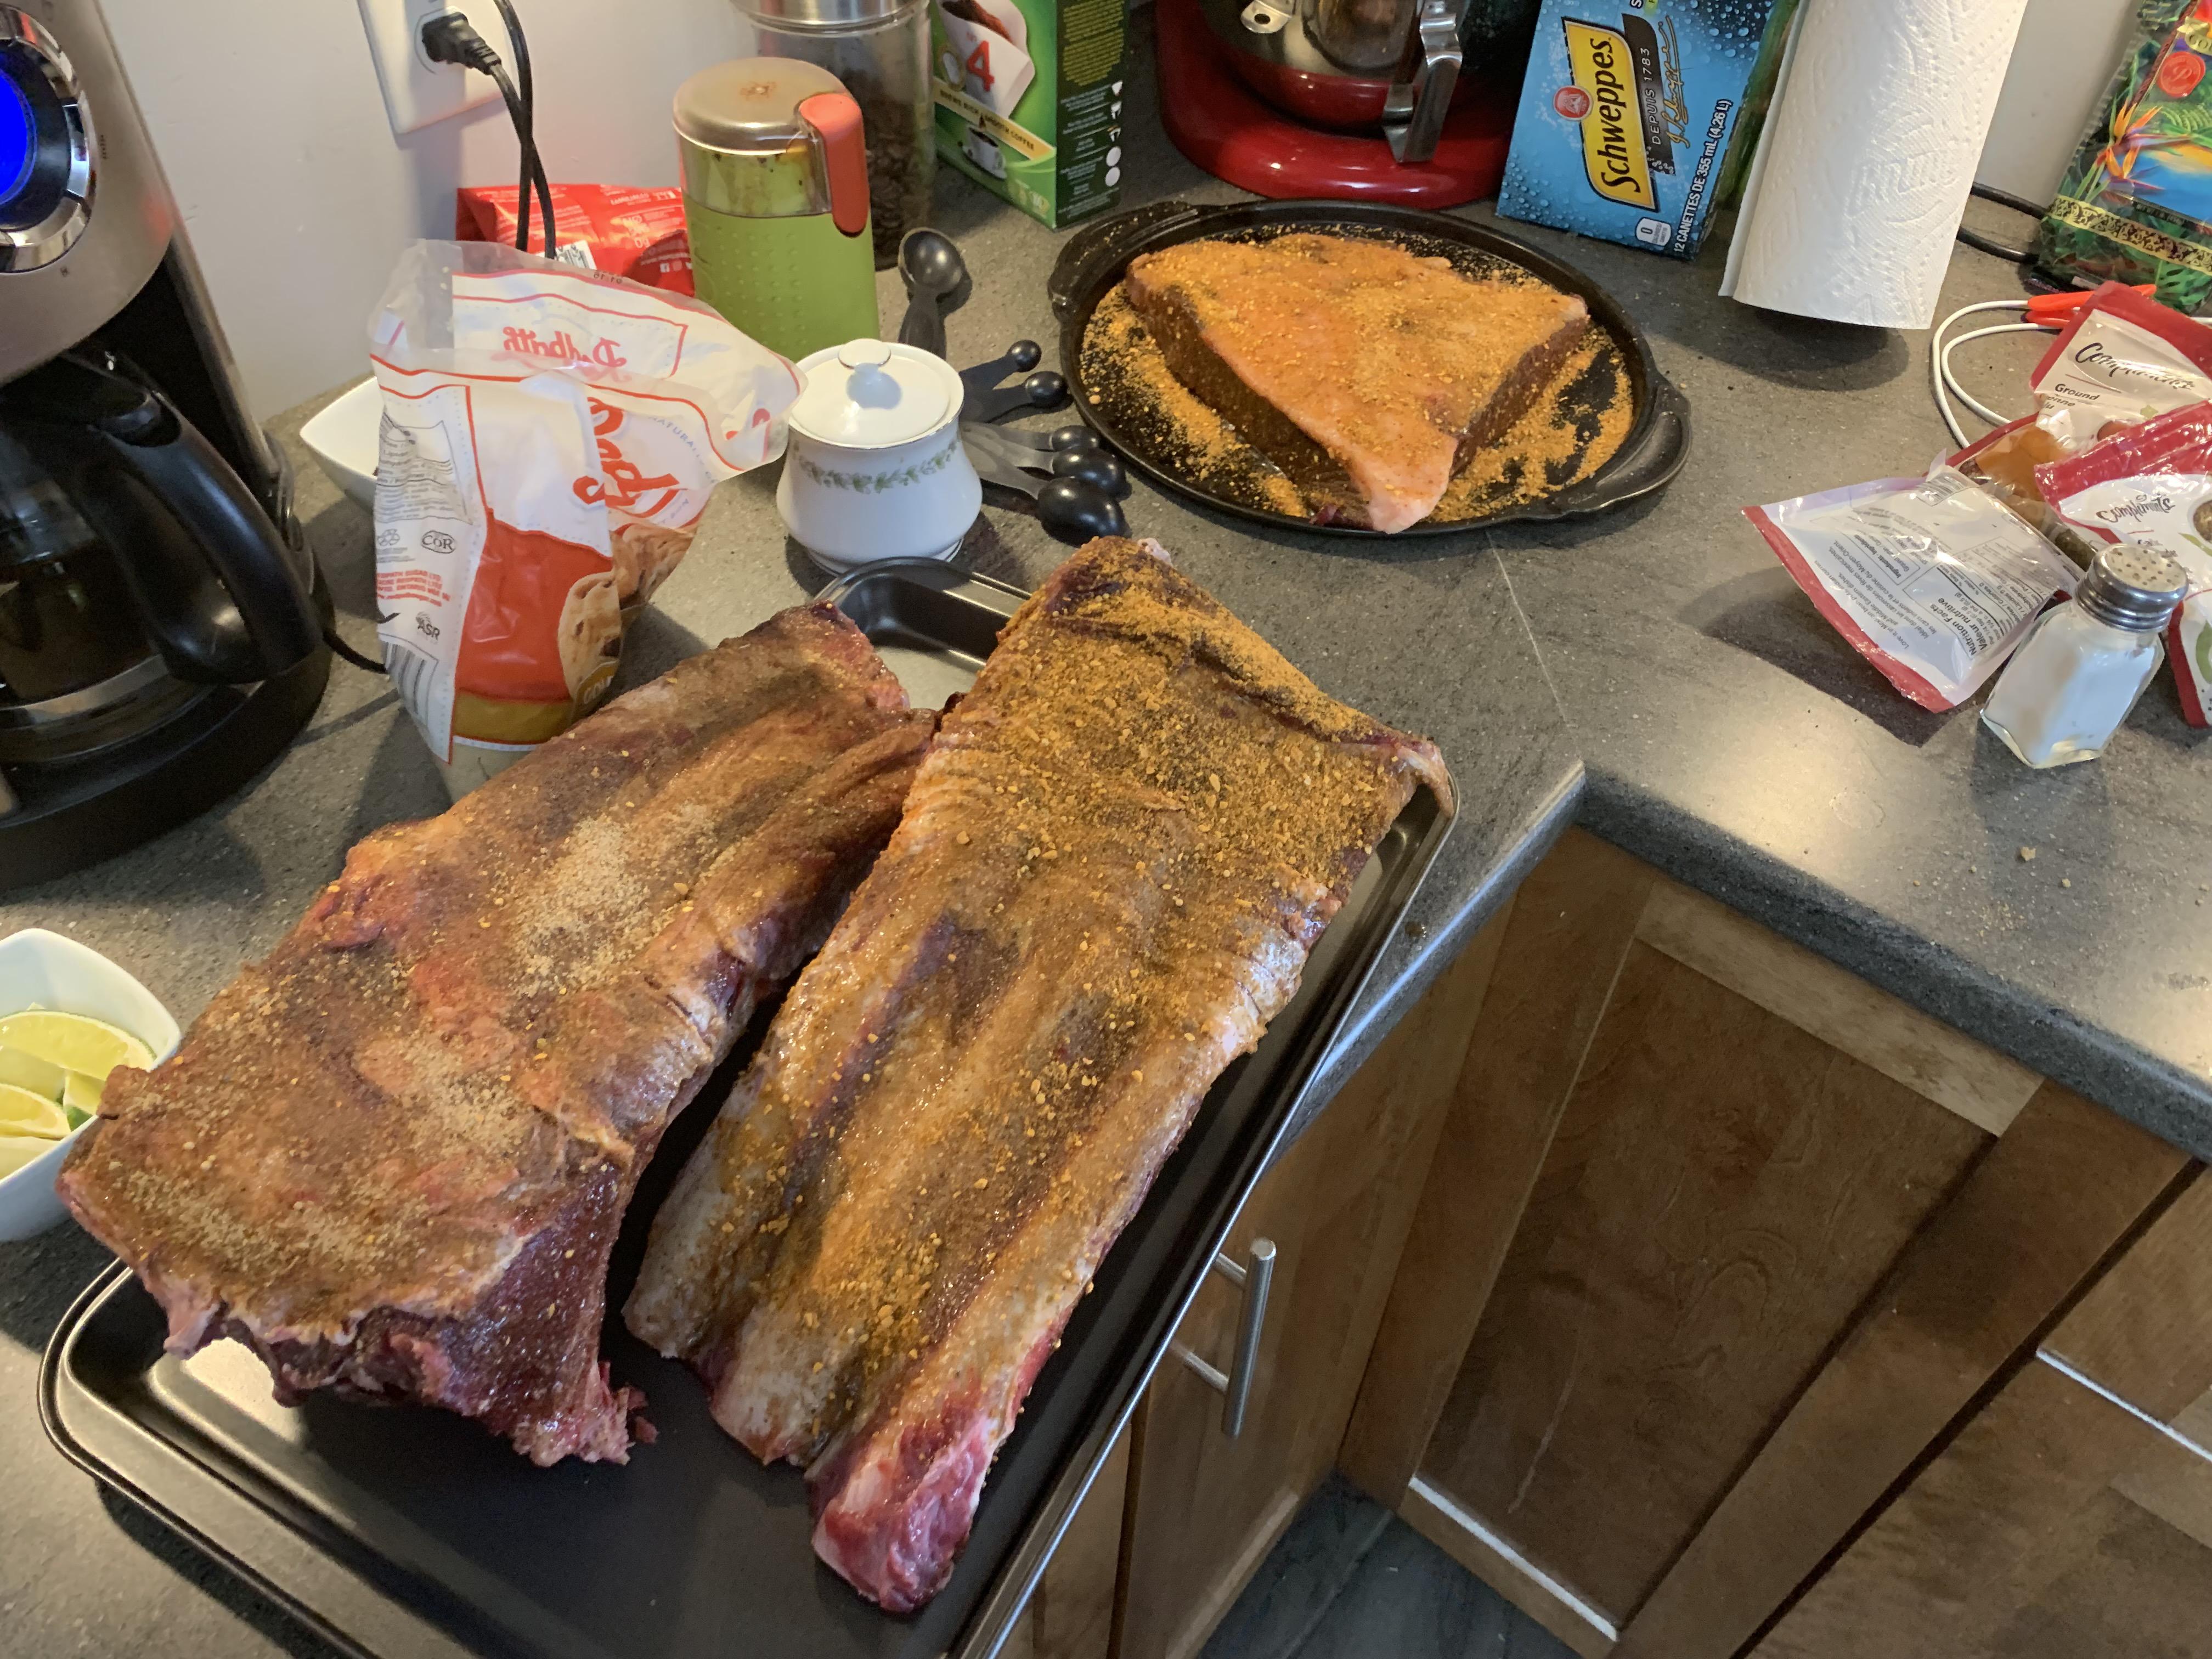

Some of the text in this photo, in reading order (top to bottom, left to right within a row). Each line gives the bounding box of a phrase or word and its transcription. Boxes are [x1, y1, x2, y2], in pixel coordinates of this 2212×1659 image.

[967, 40, 995, 92] 4
[1640, 48, 1661, 145] DEPUIS 1783
[1590, 37, 1641, 193] Schweppes
[1708, 112, 1725, 138] (4,26
[1705, 140, 1718, 156] mL
[1697, 157, 1712, 177] 355
[1692, 177, 1705, 193] DE
[1677, 193, 1701, 242] CANETTES
[1640, 227, 1654, 235] 0
[1674, 242, 1685, 252] 12
[2055, 383, 2101, 401] Ground
[1863, 570, 1873, 580] du
[1877, 554, 1901, 579] Ingredients
[1852, 586, 1871, 606] Eastern
[1864, 583, 1874, 592] de
[1866, 611, 1887, 629] Mexian
[1869, 603, 1888, 620] Middle
[1937, 596, 1971, 624] nutritive
[417, 619, 441, 640] ASR
[1885, 618, 1898, 627] and
[1929, 603, 1977, 656] Nutrition Facts
[1894, 635, 1910, 650] Love
[1968, 624, 1988, 650] Valeur
